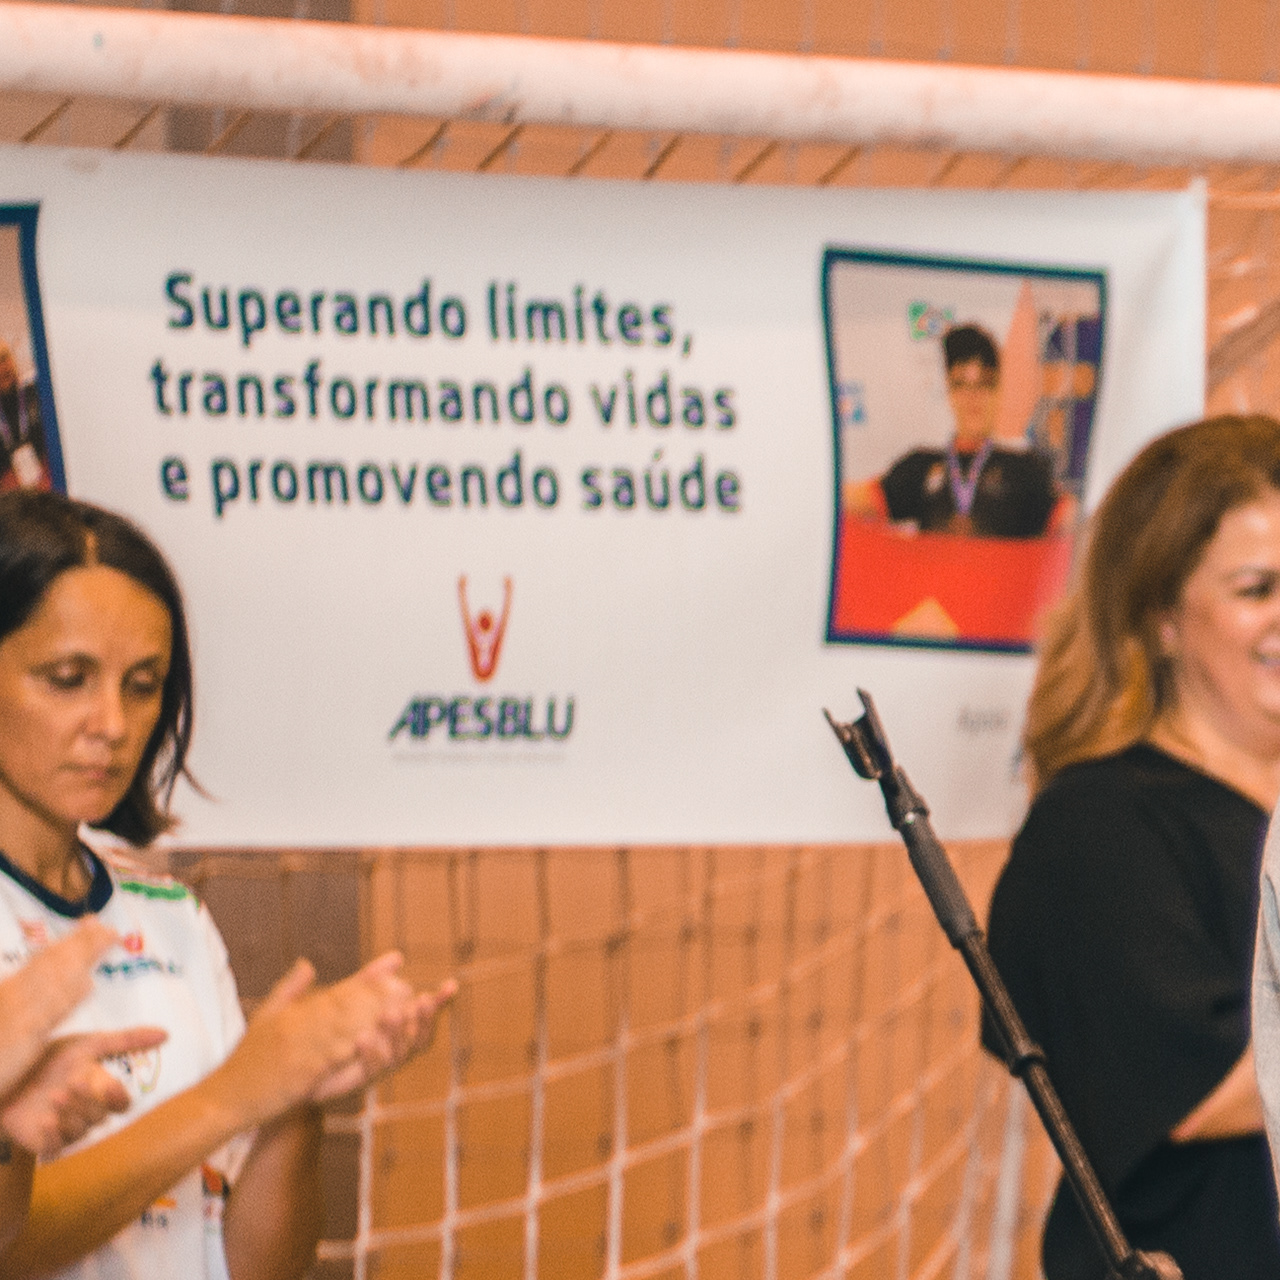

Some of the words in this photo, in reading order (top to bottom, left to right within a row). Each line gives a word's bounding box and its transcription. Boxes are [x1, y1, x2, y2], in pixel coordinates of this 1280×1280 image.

[165, 272, 466, 348] Superando
[488, 279, 692, 358] limites,
[150, 359, 570, 426] transformando
[590, 369, 736, 428] vidas
[161, 456, 189, 500] e
[210, 451, 558, 518] promovendo
[581, 450, 740, 512] saúde
[388, 696, 575, 739] APESBLU
